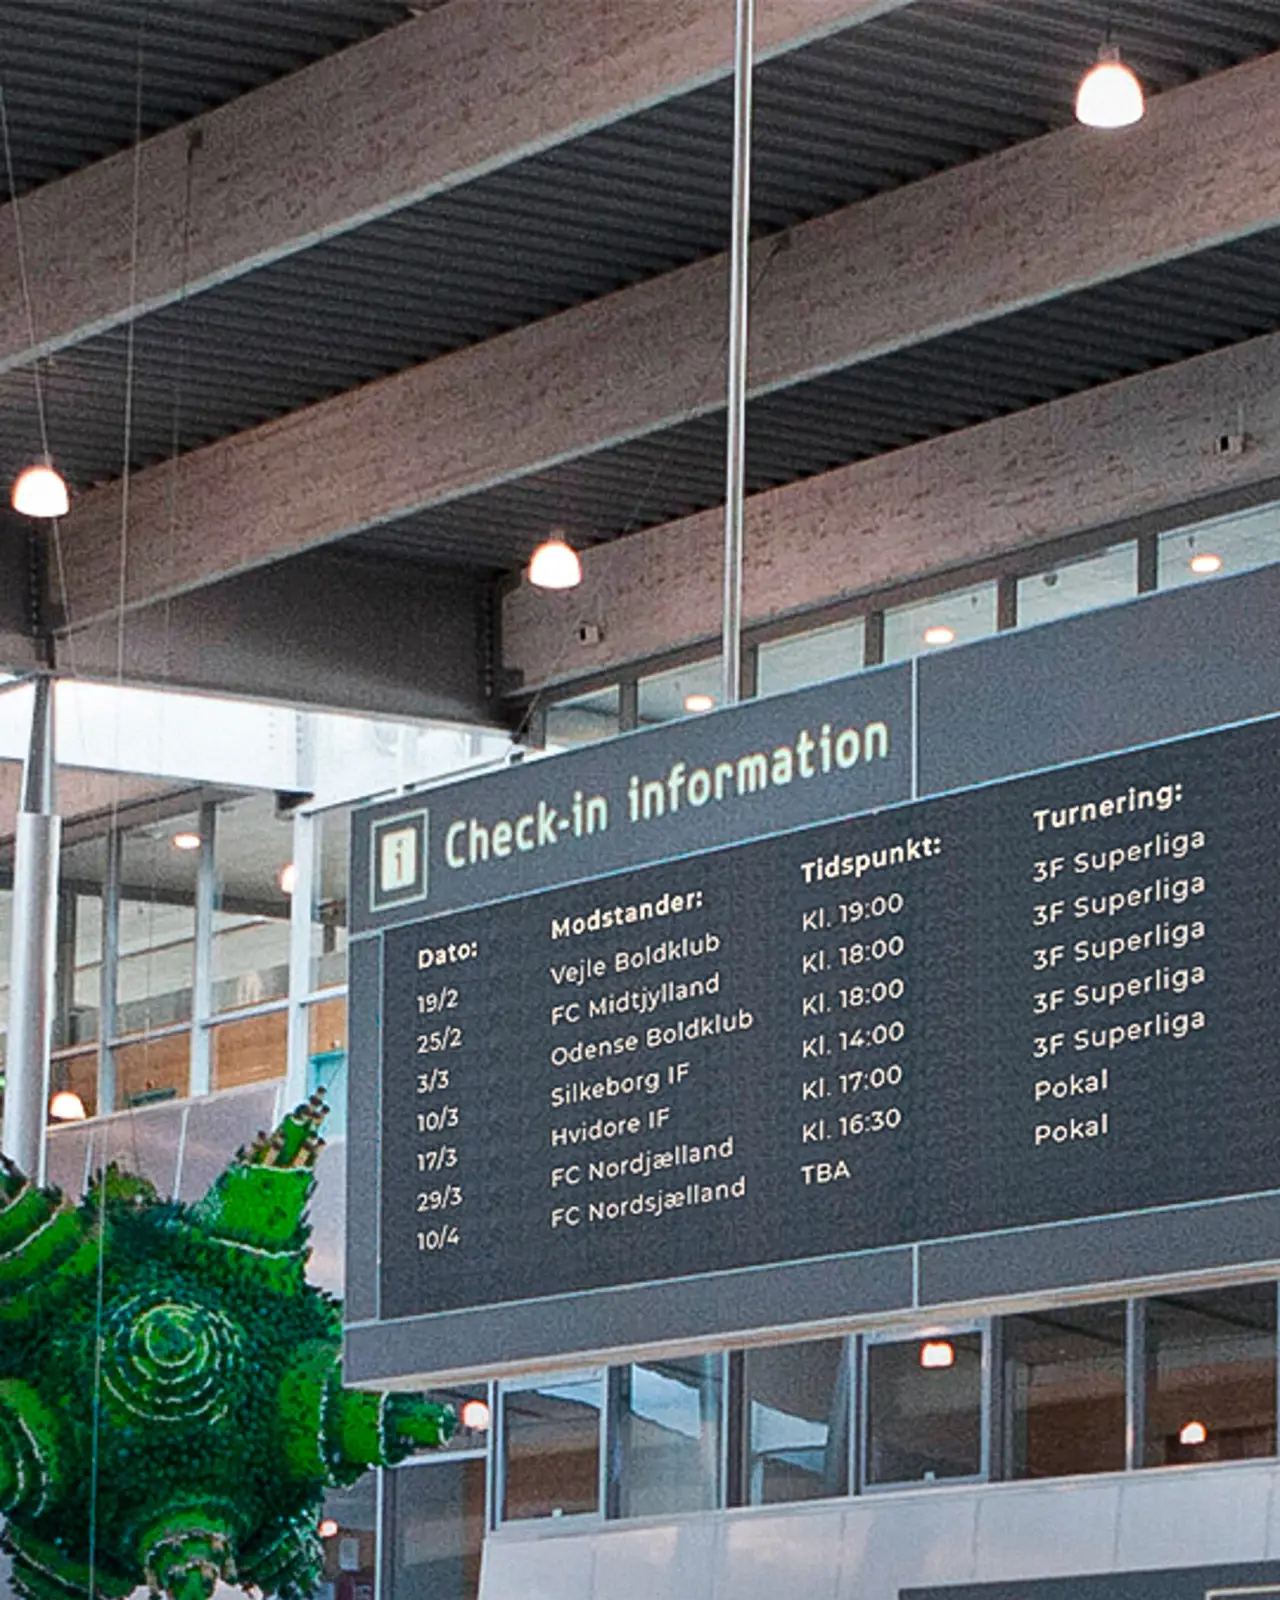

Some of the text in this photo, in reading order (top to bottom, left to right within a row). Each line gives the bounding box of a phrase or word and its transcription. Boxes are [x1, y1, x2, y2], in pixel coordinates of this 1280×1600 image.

[417, 938, 479, 970] Dato:
[550, 890, 704, 939] Modstander:
[801, 834, 942, 885] Tidspunkt:
[1034, 783, 1183, 832] Turnering:
[445, 792, 608, 869] Check-in
[628, 720, 889, 823] information
[416, 989, 460, 1014] 19/2
[550, 957, 606, 987] Vejle
[614, 932, 721, 975] Boldklub
[802, 906, 832, 932] Kl.
[839, 893, 904, 924] 19:00
[1033, 858, 1065, 883] 3F
[1074, 831, 1205, 874] Superliga
[416, 1027, 463, 1055] 25/2
[550, 1001, 581, 1026] FC
[589, 973, 721, 1022] Midtjylland
[802, 949, 832, 975] Kl.
[839, 935, 904, 966] 18:00
[1033, 902, 1065, 926] 3F
[1074, 876, 1205, 917] Superliga
[416, 1070, 450, 1094] 3/3
[550, 1034, 639, 1067] Odense
[646, 1009, 754, 1048] Boldklub
[802, 991, 832, 1018] Kl.
[839, 978, 904, 1009] 18:00
[1033, 946, 1065, 970] 3F
[1074, 921, 1205, 961] Superliga
[416, 1108, 460, 1135] 10/3
[550, 1072, 660, 1108] Silkeborg
[668, 1062, 691, 1085] IF
[802, 1033, 832, 1060] Kl.
[839, 1021, 904, 1051] 14:00
[1033, 990, 1065, 1014] 3F
[1074, 965, 1205, 1005] Superliga
[416, 1148, 458, 1173] 17/3
[550, 1114, 640, 1149] Hvidore
[648, 1108, 671, 1129] IF
[802, 1076, 832, 1102] Kl.
[839, 1064, 904, 1093] 17:00
[1033, 1034, 1065, 1058] 3F
[1074, 1010, 1205, 1049] Superliga
[416, 1186, 463, 1213] 29/3
[550, 1167, 581, 1188] FC
[589, 1136, 735, 1181] Nordjælland
[802, 1118, 832, 1145] Kl.
[839, 1108, 904, 1136] 16:30
[1034, 1069, 1108, 1101] Pokal
[416, 1227, 461, 1251] 10/4
[550, 1208, 581, 1229] FC
[589, 1176, 746, 1224] Nordsjælland
[802, 1160, 851, 1185] TBA
[1034, 1114, 1108, 1145] Pokal
